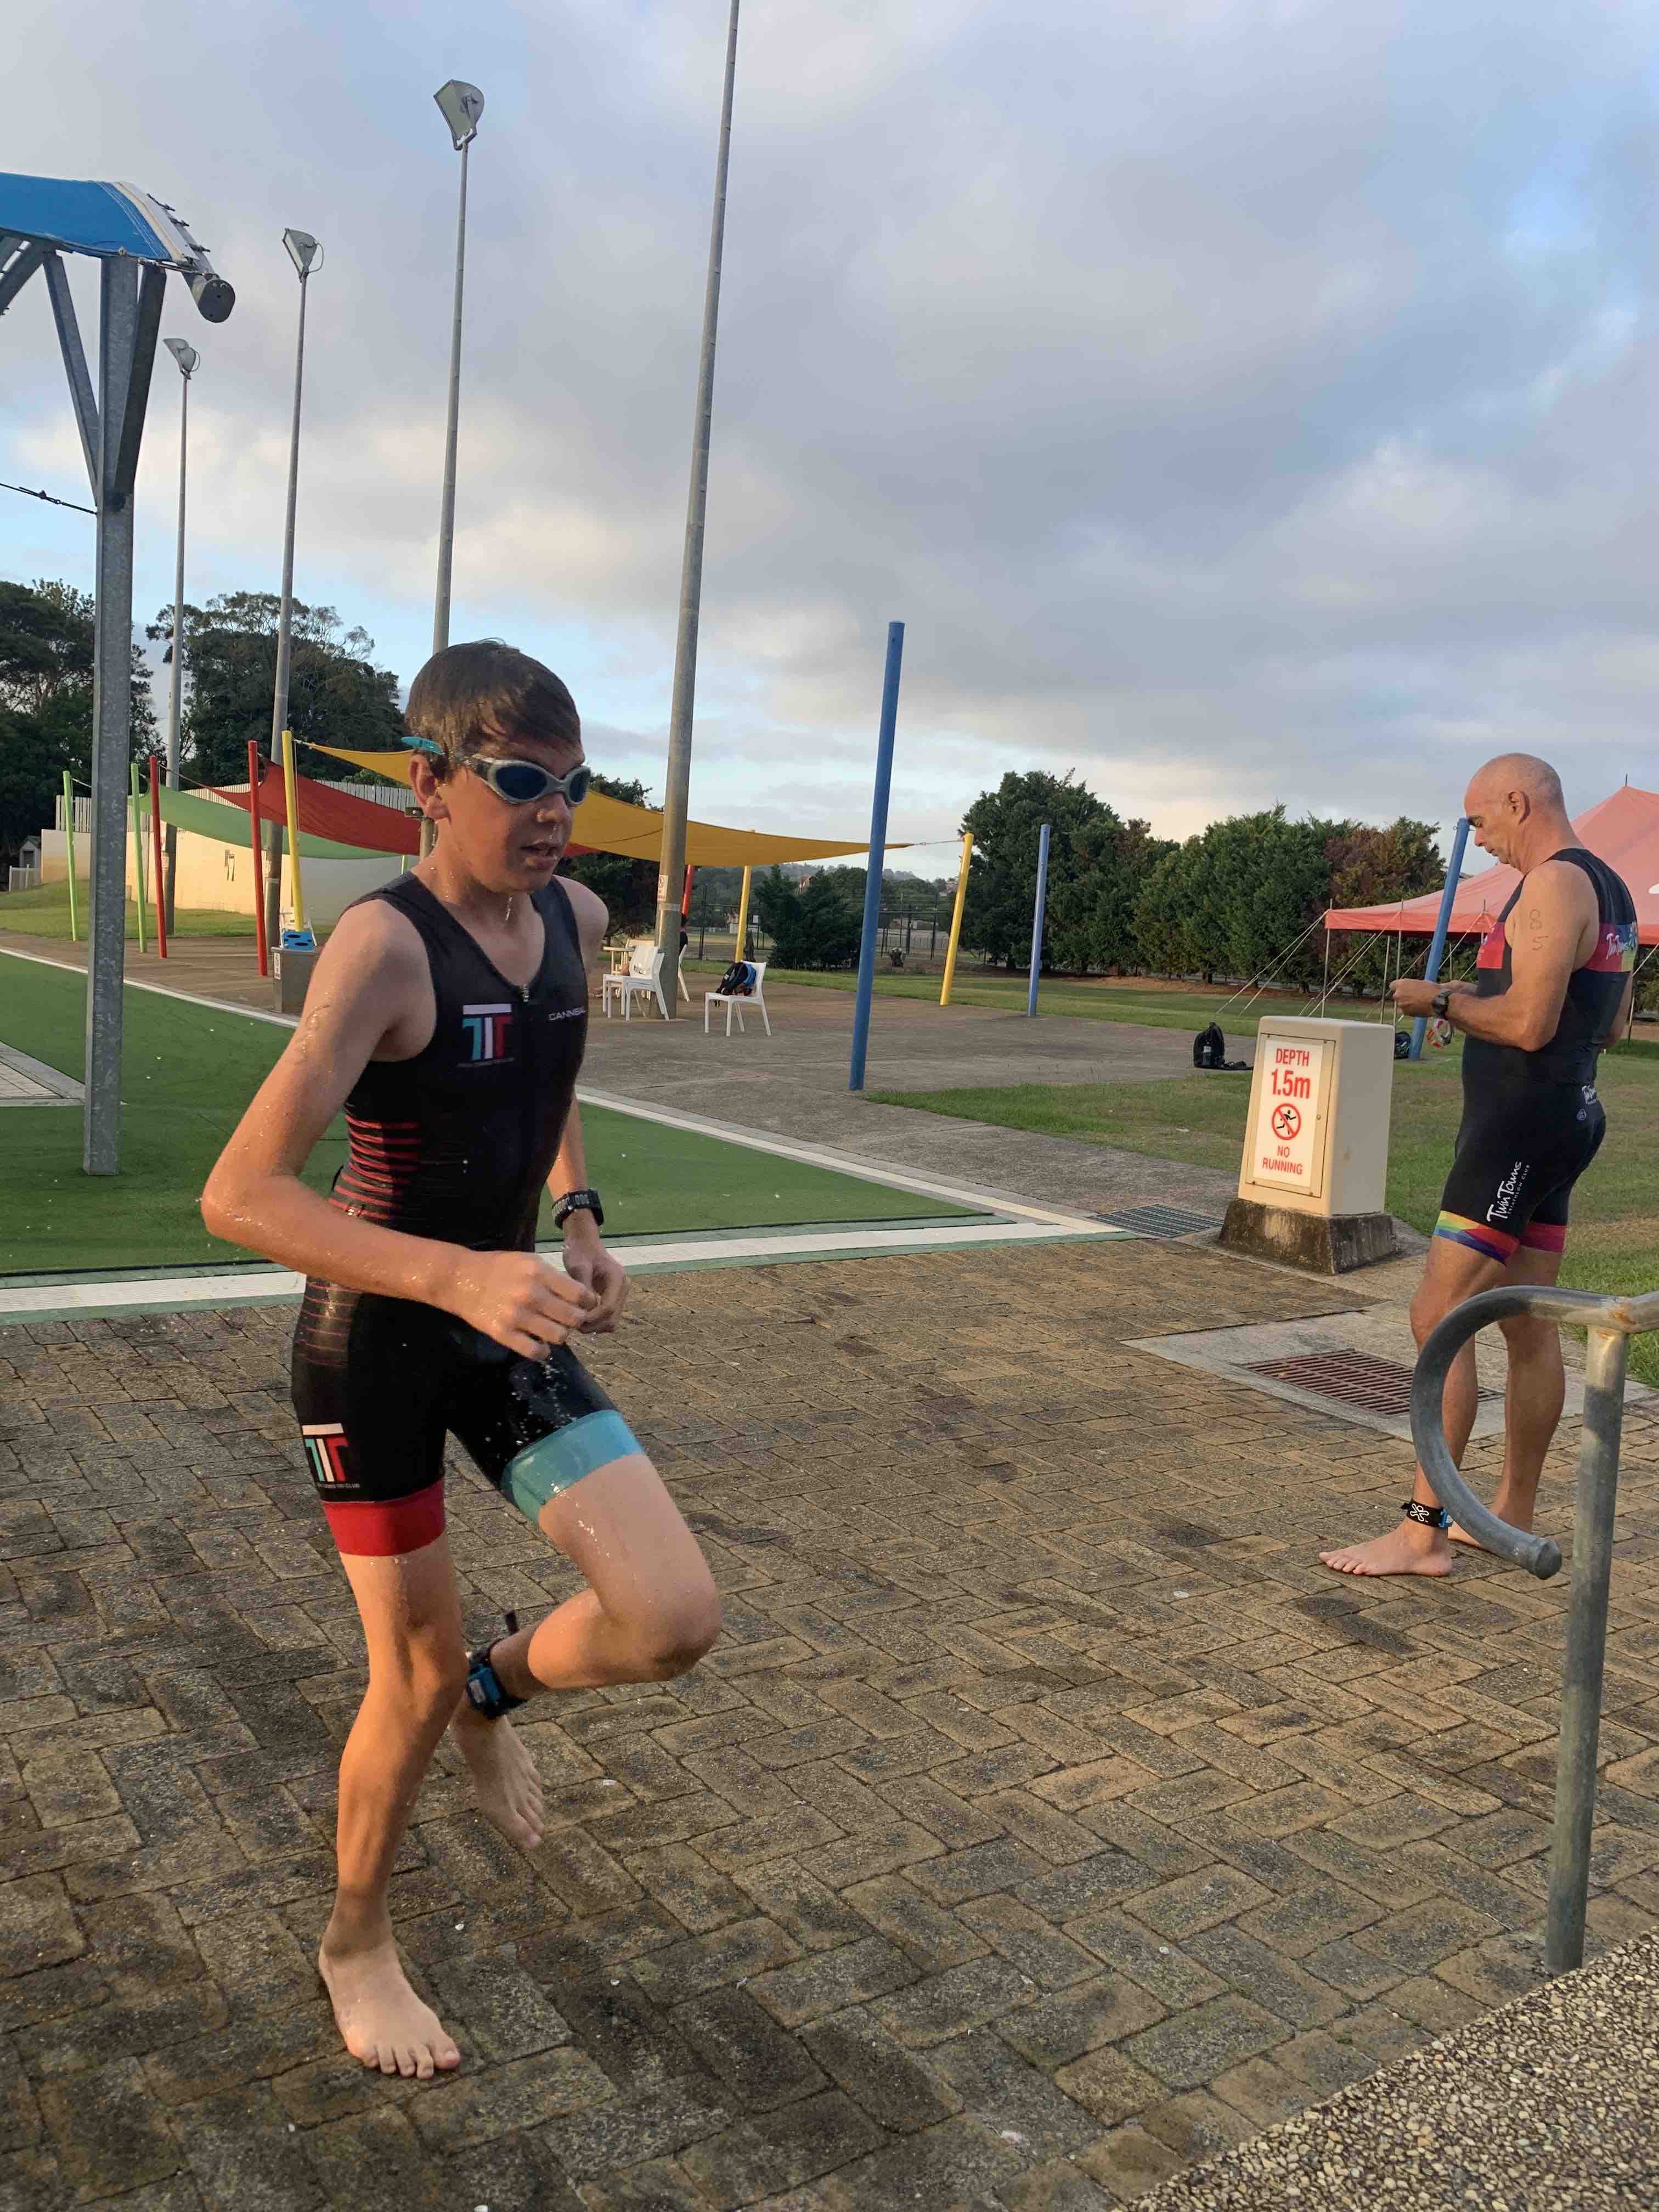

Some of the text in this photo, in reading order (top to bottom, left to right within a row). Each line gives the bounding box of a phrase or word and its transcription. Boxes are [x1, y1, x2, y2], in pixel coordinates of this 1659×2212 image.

[1275, 1047, 1310, 1066] DEPTH
[1271, 1068, 1311, 1099] 1.5m
[1277, 1145, 1290, 1158] NO
[1262, 1157, 1304, 1175] RUNNING
[1486, 1161, 1522, 1222] Twin Towns
